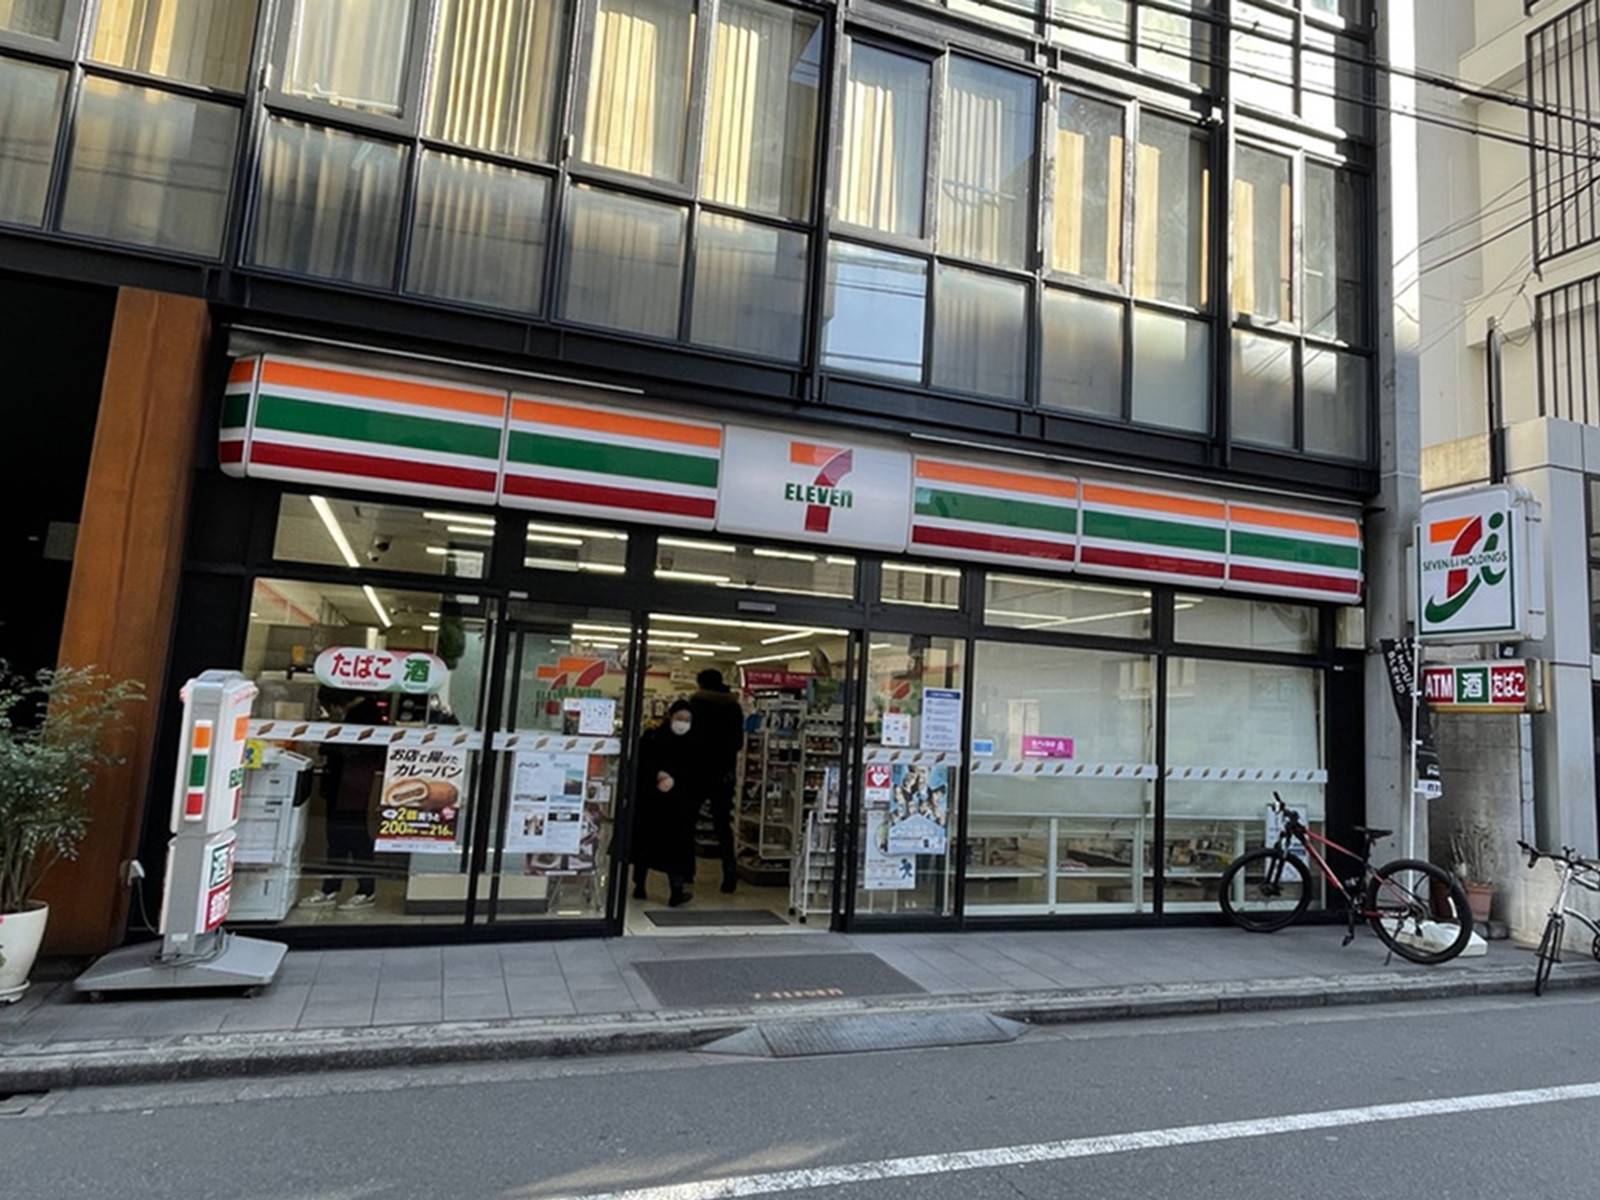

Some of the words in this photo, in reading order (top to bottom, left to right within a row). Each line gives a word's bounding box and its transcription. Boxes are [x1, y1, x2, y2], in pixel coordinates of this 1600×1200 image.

[331, 653, 392, 680] たばこ
[403, 658, 431, 683] 酒
[1424, 674, 1454, 699] ATM
[1462, 672, 1484, 699] 酒
[1492, 670, 1525, 698] たばこ
[392, 763, 463, 778] カレーパン
